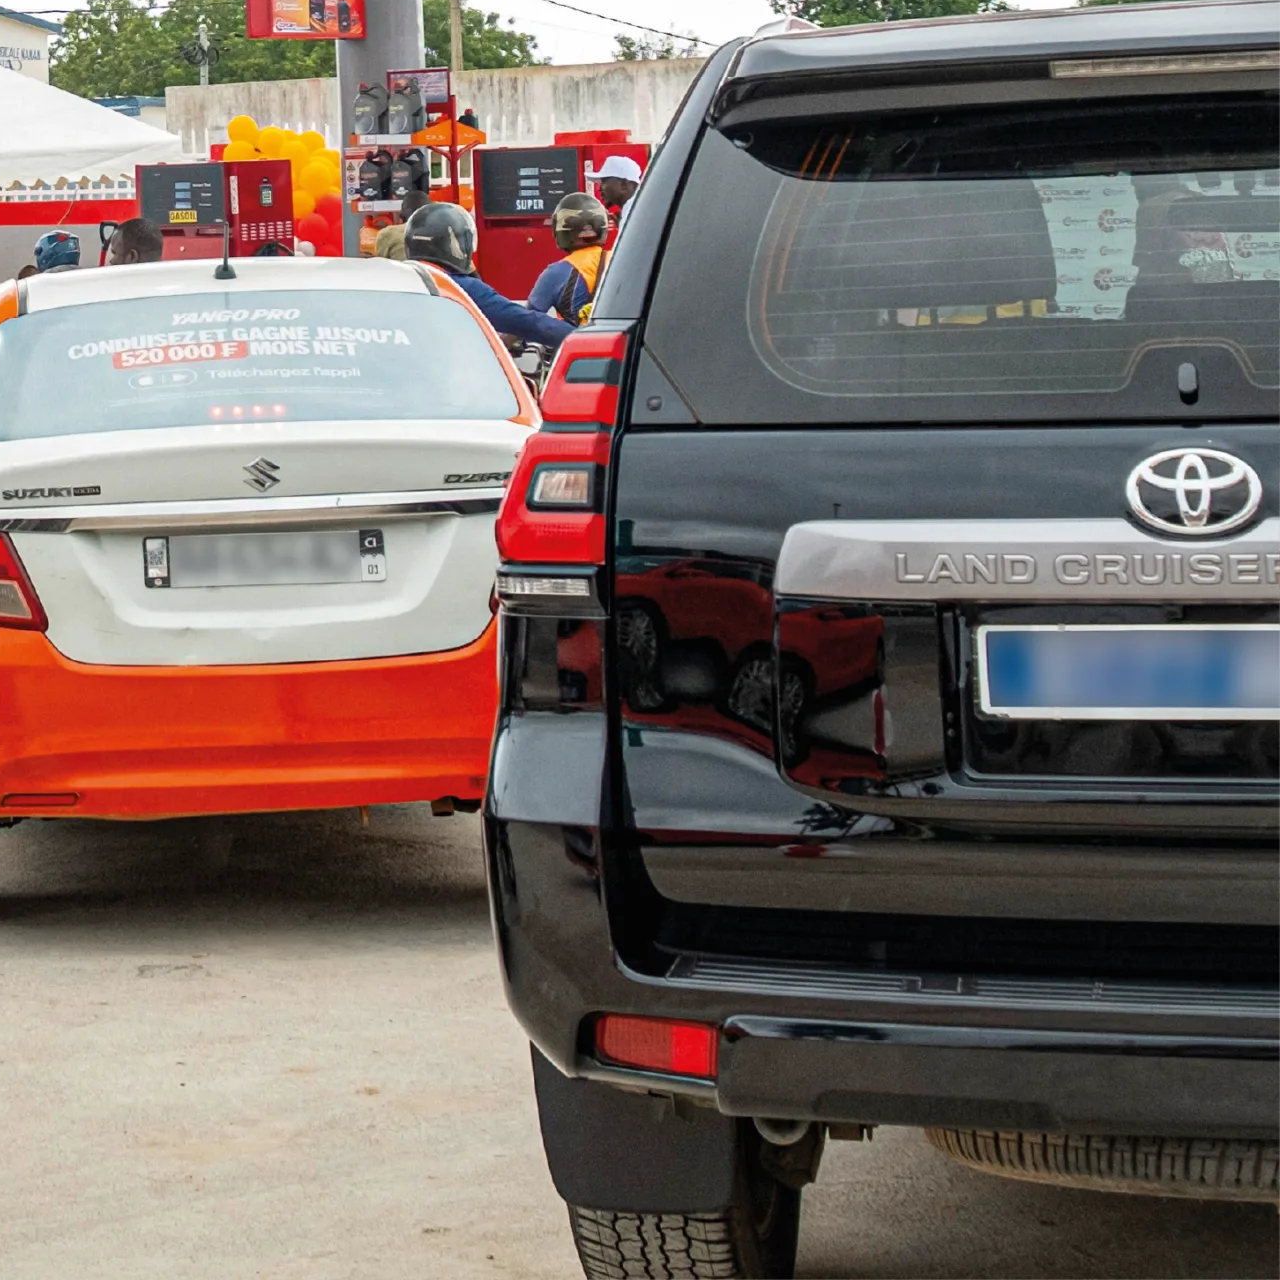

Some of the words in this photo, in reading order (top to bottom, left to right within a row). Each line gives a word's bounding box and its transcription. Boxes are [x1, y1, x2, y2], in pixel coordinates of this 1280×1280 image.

[516, 199, 544, 210] SUPER
[172, 310, 250, 326] YANGO
[250, 308, 301, 321] PRO
[68, 330, 194, 360] CONDUISEZ
[197, 328, 228, 342] ET
[231, 326, 311, 342] GAGNE
[121, 348, 164, 368] 520
[168, 343, 216, 362] 000
[249, 340, 311, 357] MOIS
[313, 341, 358, 357] NET
[206, 367, 311, 379] Téléchargez
[2, 487, 72, 500] SUZUKI
[894, 552, 1037, 585] LAND
